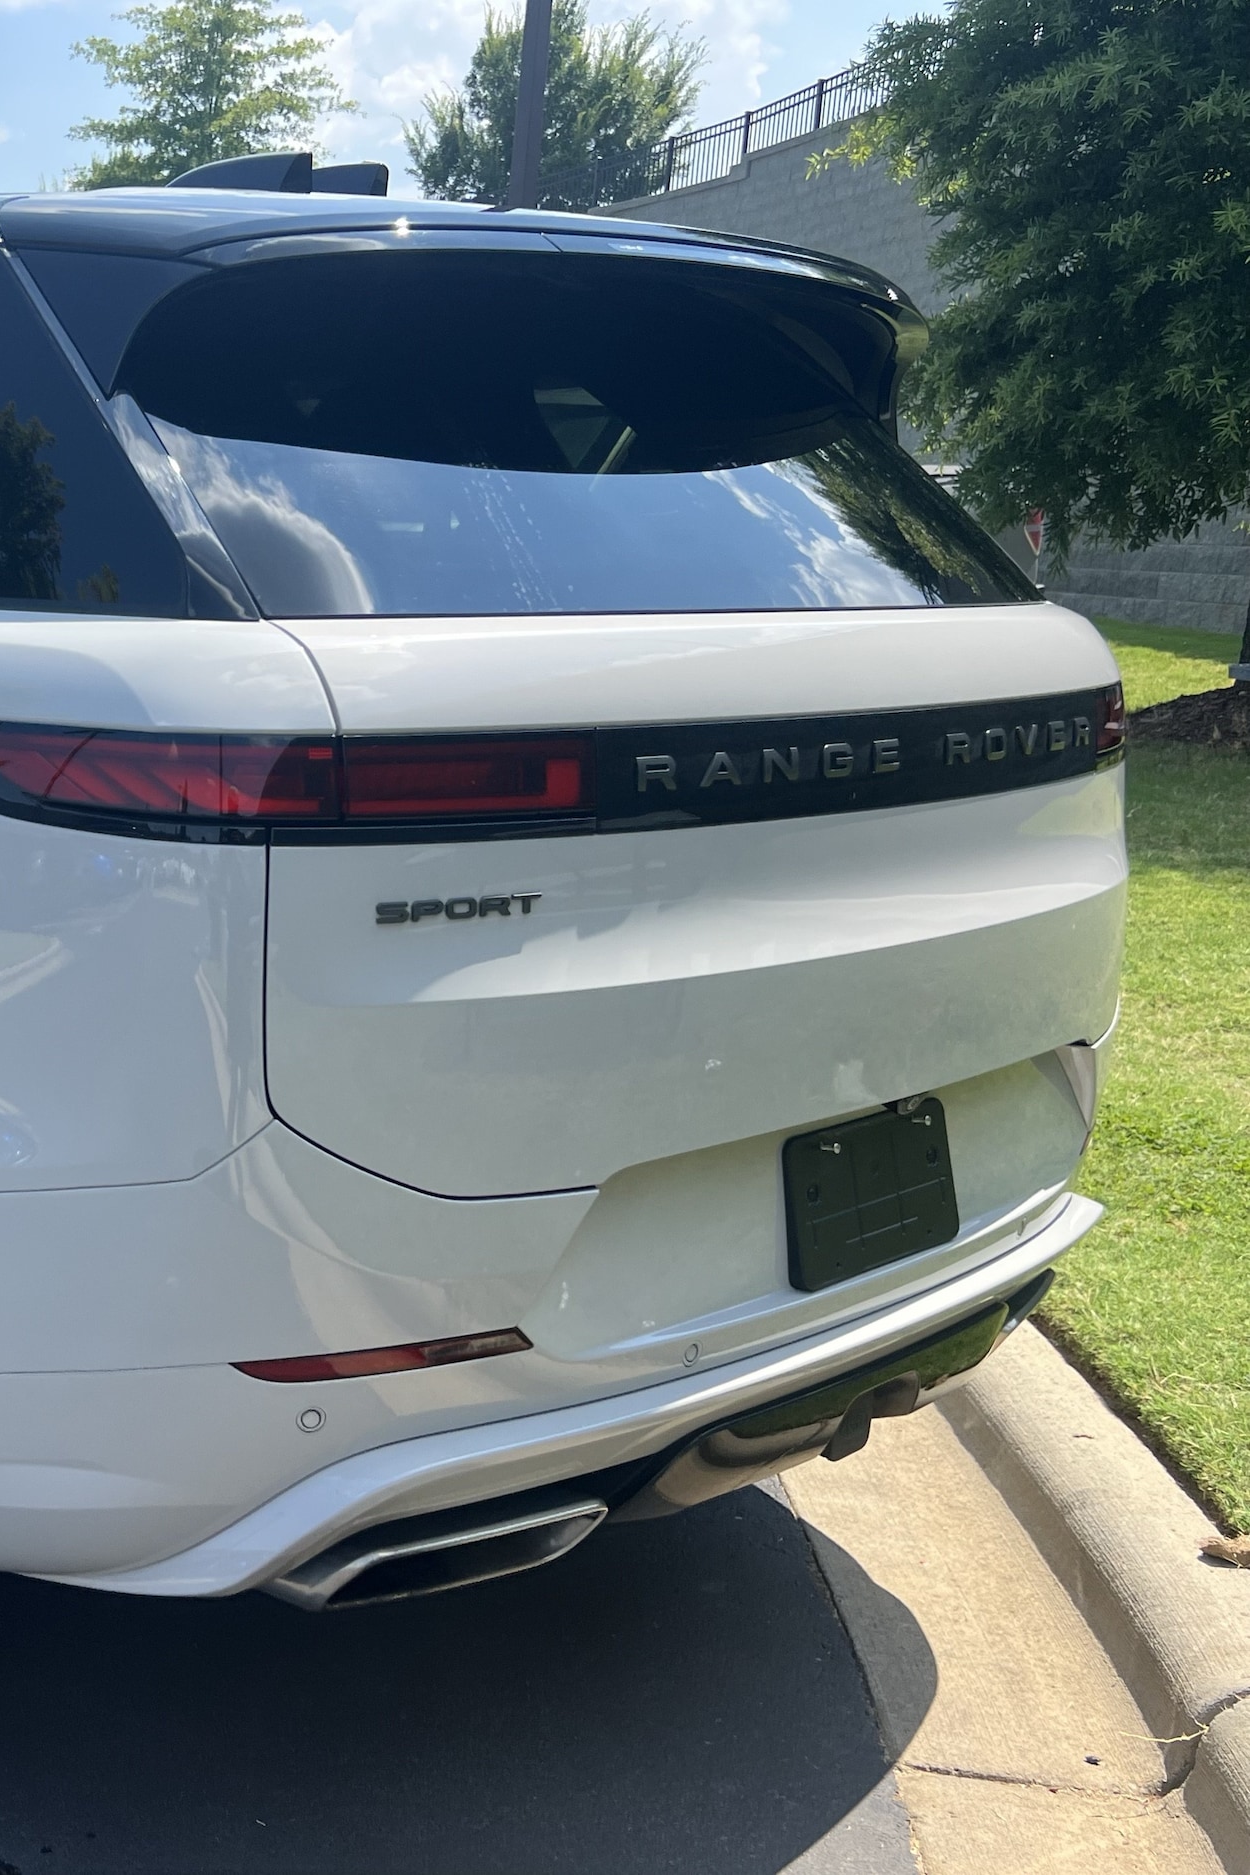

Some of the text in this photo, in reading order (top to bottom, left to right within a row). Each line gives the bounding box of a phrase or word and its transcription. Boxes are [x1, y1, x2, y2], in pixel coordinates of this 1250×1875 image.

[635, 717, 1090, 792] RANGE ROVER
[375, 891, 542, 925] SPORT
